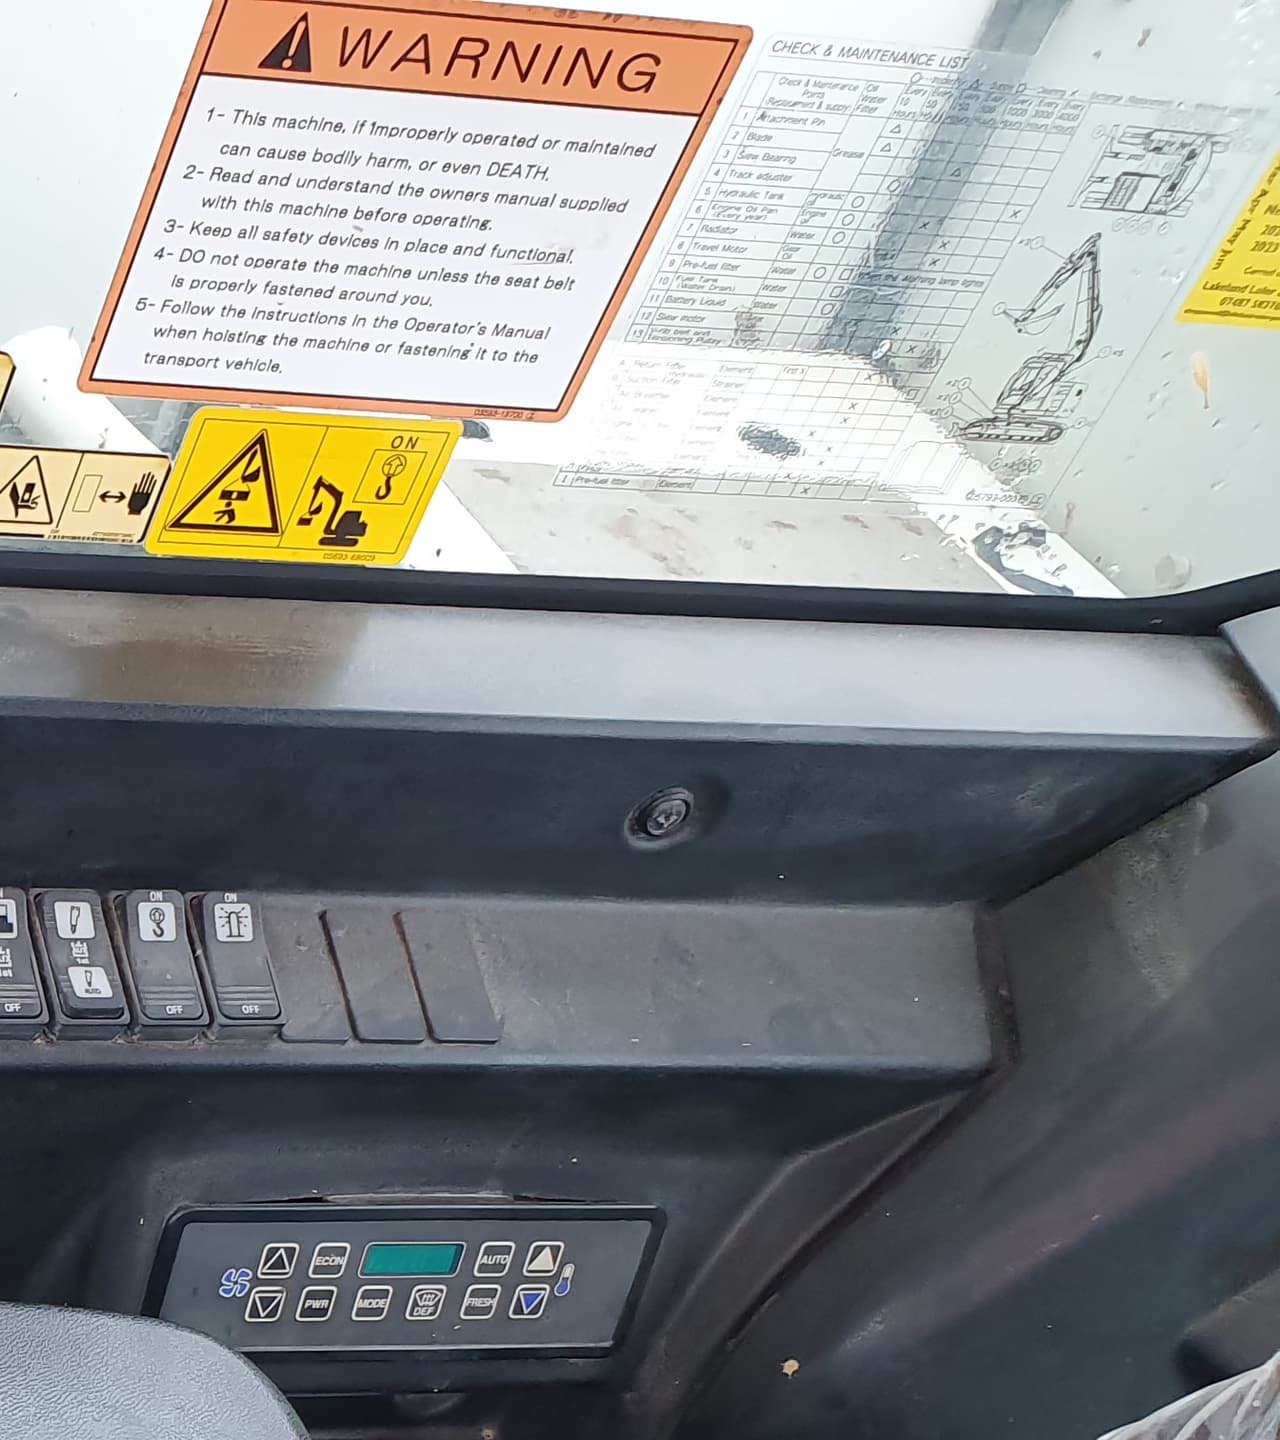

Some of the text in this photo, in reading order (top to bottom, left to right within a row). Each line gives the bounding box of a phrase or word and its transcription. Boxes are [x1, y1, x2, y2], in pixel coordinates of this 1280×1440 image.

[338, 25, 663, 94] WARNING
[772, 40, 970, 70] CHECK & MAINTENANCE LIST
[232, 109, 267, 127] This
[272, 115, 347, 134] machine,
[462, 130, 539, 148] operated
[541, 138, 560, 150] or
[564, 139, 657, 158] maintained
[220, 144, 250, 157] can
[256, 147, 306, 161] cause
[312, 148, 361, 167] bodily
[418, 160, 437, 171] or
[441, 163, 481, 176] even
[486, 161, 550, 182] DEATH.
[209, 167, 254, 184] Read
[257, 173, 292, 186] and
[296, 174, 393, 195] understand
[398, 183, 424, 197] the
[430, 188, 489, 202] owners
[494, 193, 556, 208] manual
[560, 196, 630, 213] supplied
[202, 196, 493, 231] with this machine before operating.
[190, 221, 232, 239] Keep
[239, 225, 258, 240] all
[262, 229, 313, 245] safety
[319, 232, 379, 250] devices
[384, 237, 399, 250] in
[404, 238, 448, 253] place
[453, 243, 485, 257] and
[490, 244, 574, 264] functional.
[179, 248, 205, 263] DO
[210, 253, 239, 266] not
[244, 256, 307, 271] operate
[313, 259, 339, 274] the
[344, 263, 411, 278] machine
[417, 268, 468, 283] unless
[474, 271, 500, 285] the
[504, 276, 539, 288] seat
[544, 276, 576, 291] belt
[171, 275, 184, 288] is
[190, 277, 257, 294] properly
[263, 281, 335, 299] fastened
[339, 289, 398, 304] around
[160, 299, 215, 315] Follow
[220, 304, 246, 318] the
[251, 306, 347, 326] instructions
[352, 314, 366, 327] in
[373, 316, 398, 329] the
[404, 317, 487, 336] Operator's
[491, 323, 551, 340] Manual
[153, 325, 539, 364] when hoisting the machine or fastening it to the
[144, 352, 283, 374] transport vehicle.
[391, 435, 419, 449] ON
[149, 890, 163, 901] ON
[224, 892, 238, 902] ON
[4, 1003, 21, 1012] OFF
[166, 1005, 183, 1015] OFF
[242, 1005, 260, 1014] OFF
[314, 1254, 345, 1266] ECON
[479, 1253, 509, 1266] AUTO
[304, 1299, 329, 1311] PWR
[357, 1298, 386, 1310] MODE
[413, 1305, 435, 1317] DEF
[465, 1297, 496, 1309] FRESH
